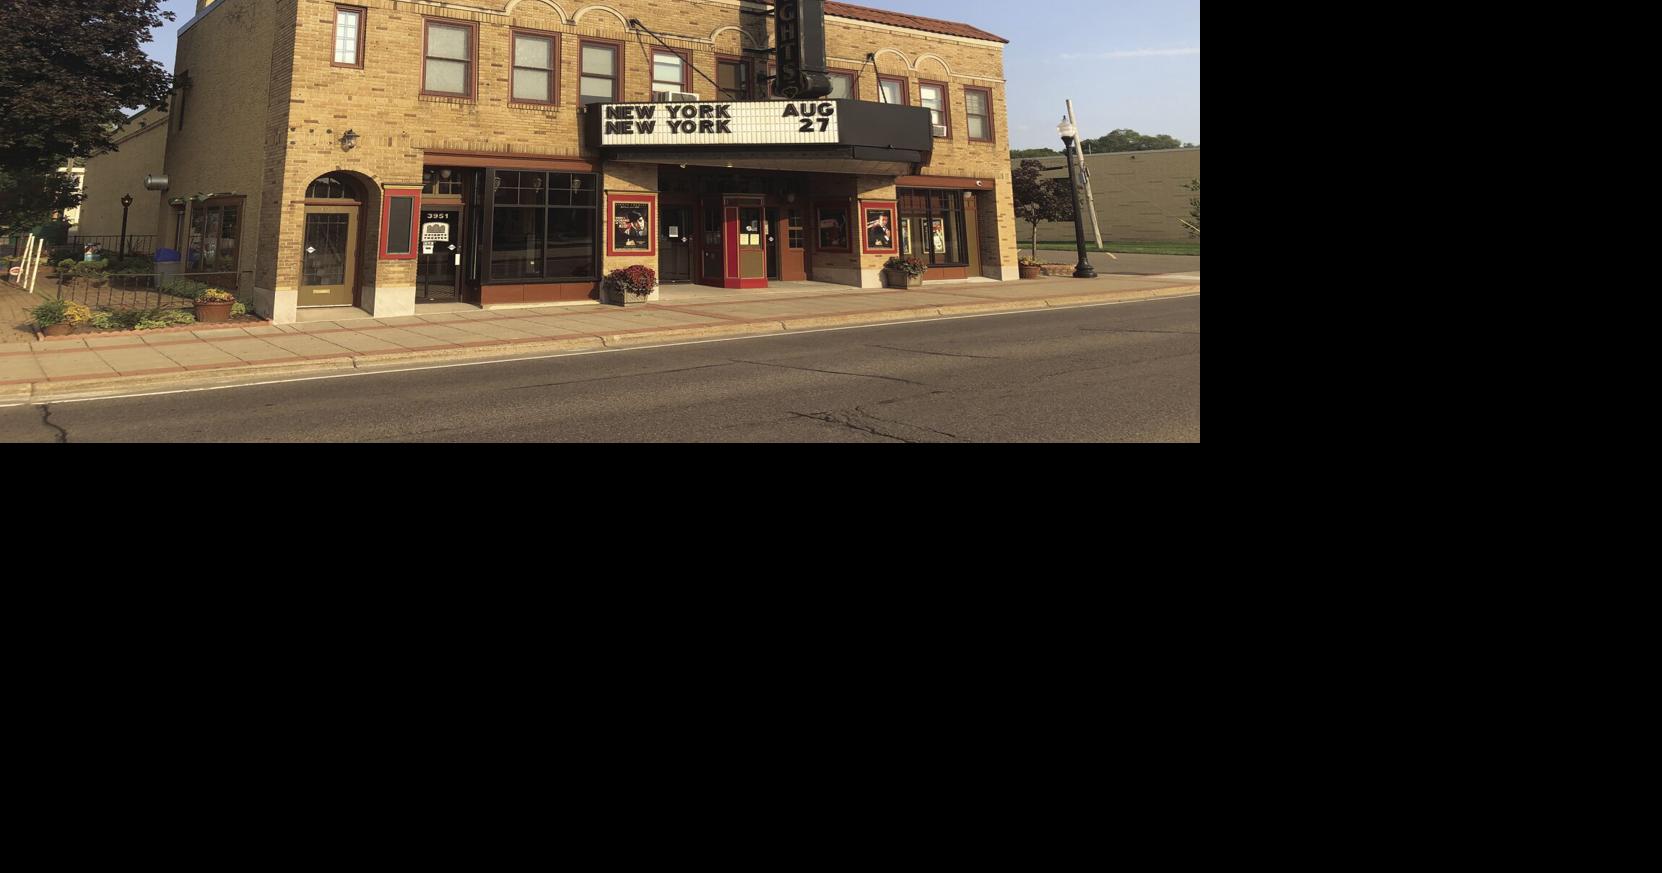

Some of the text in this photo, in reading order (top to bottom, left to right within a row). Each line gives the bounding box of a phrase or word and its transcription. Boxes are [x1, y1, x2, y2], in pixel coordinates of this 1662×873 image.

[606, 105, 731, 119] NEW YORK
[782, 103, 834, 117] AUG
[605, 120, 731, 134] NEW YORK
[799, 118, 829, 132] 27
